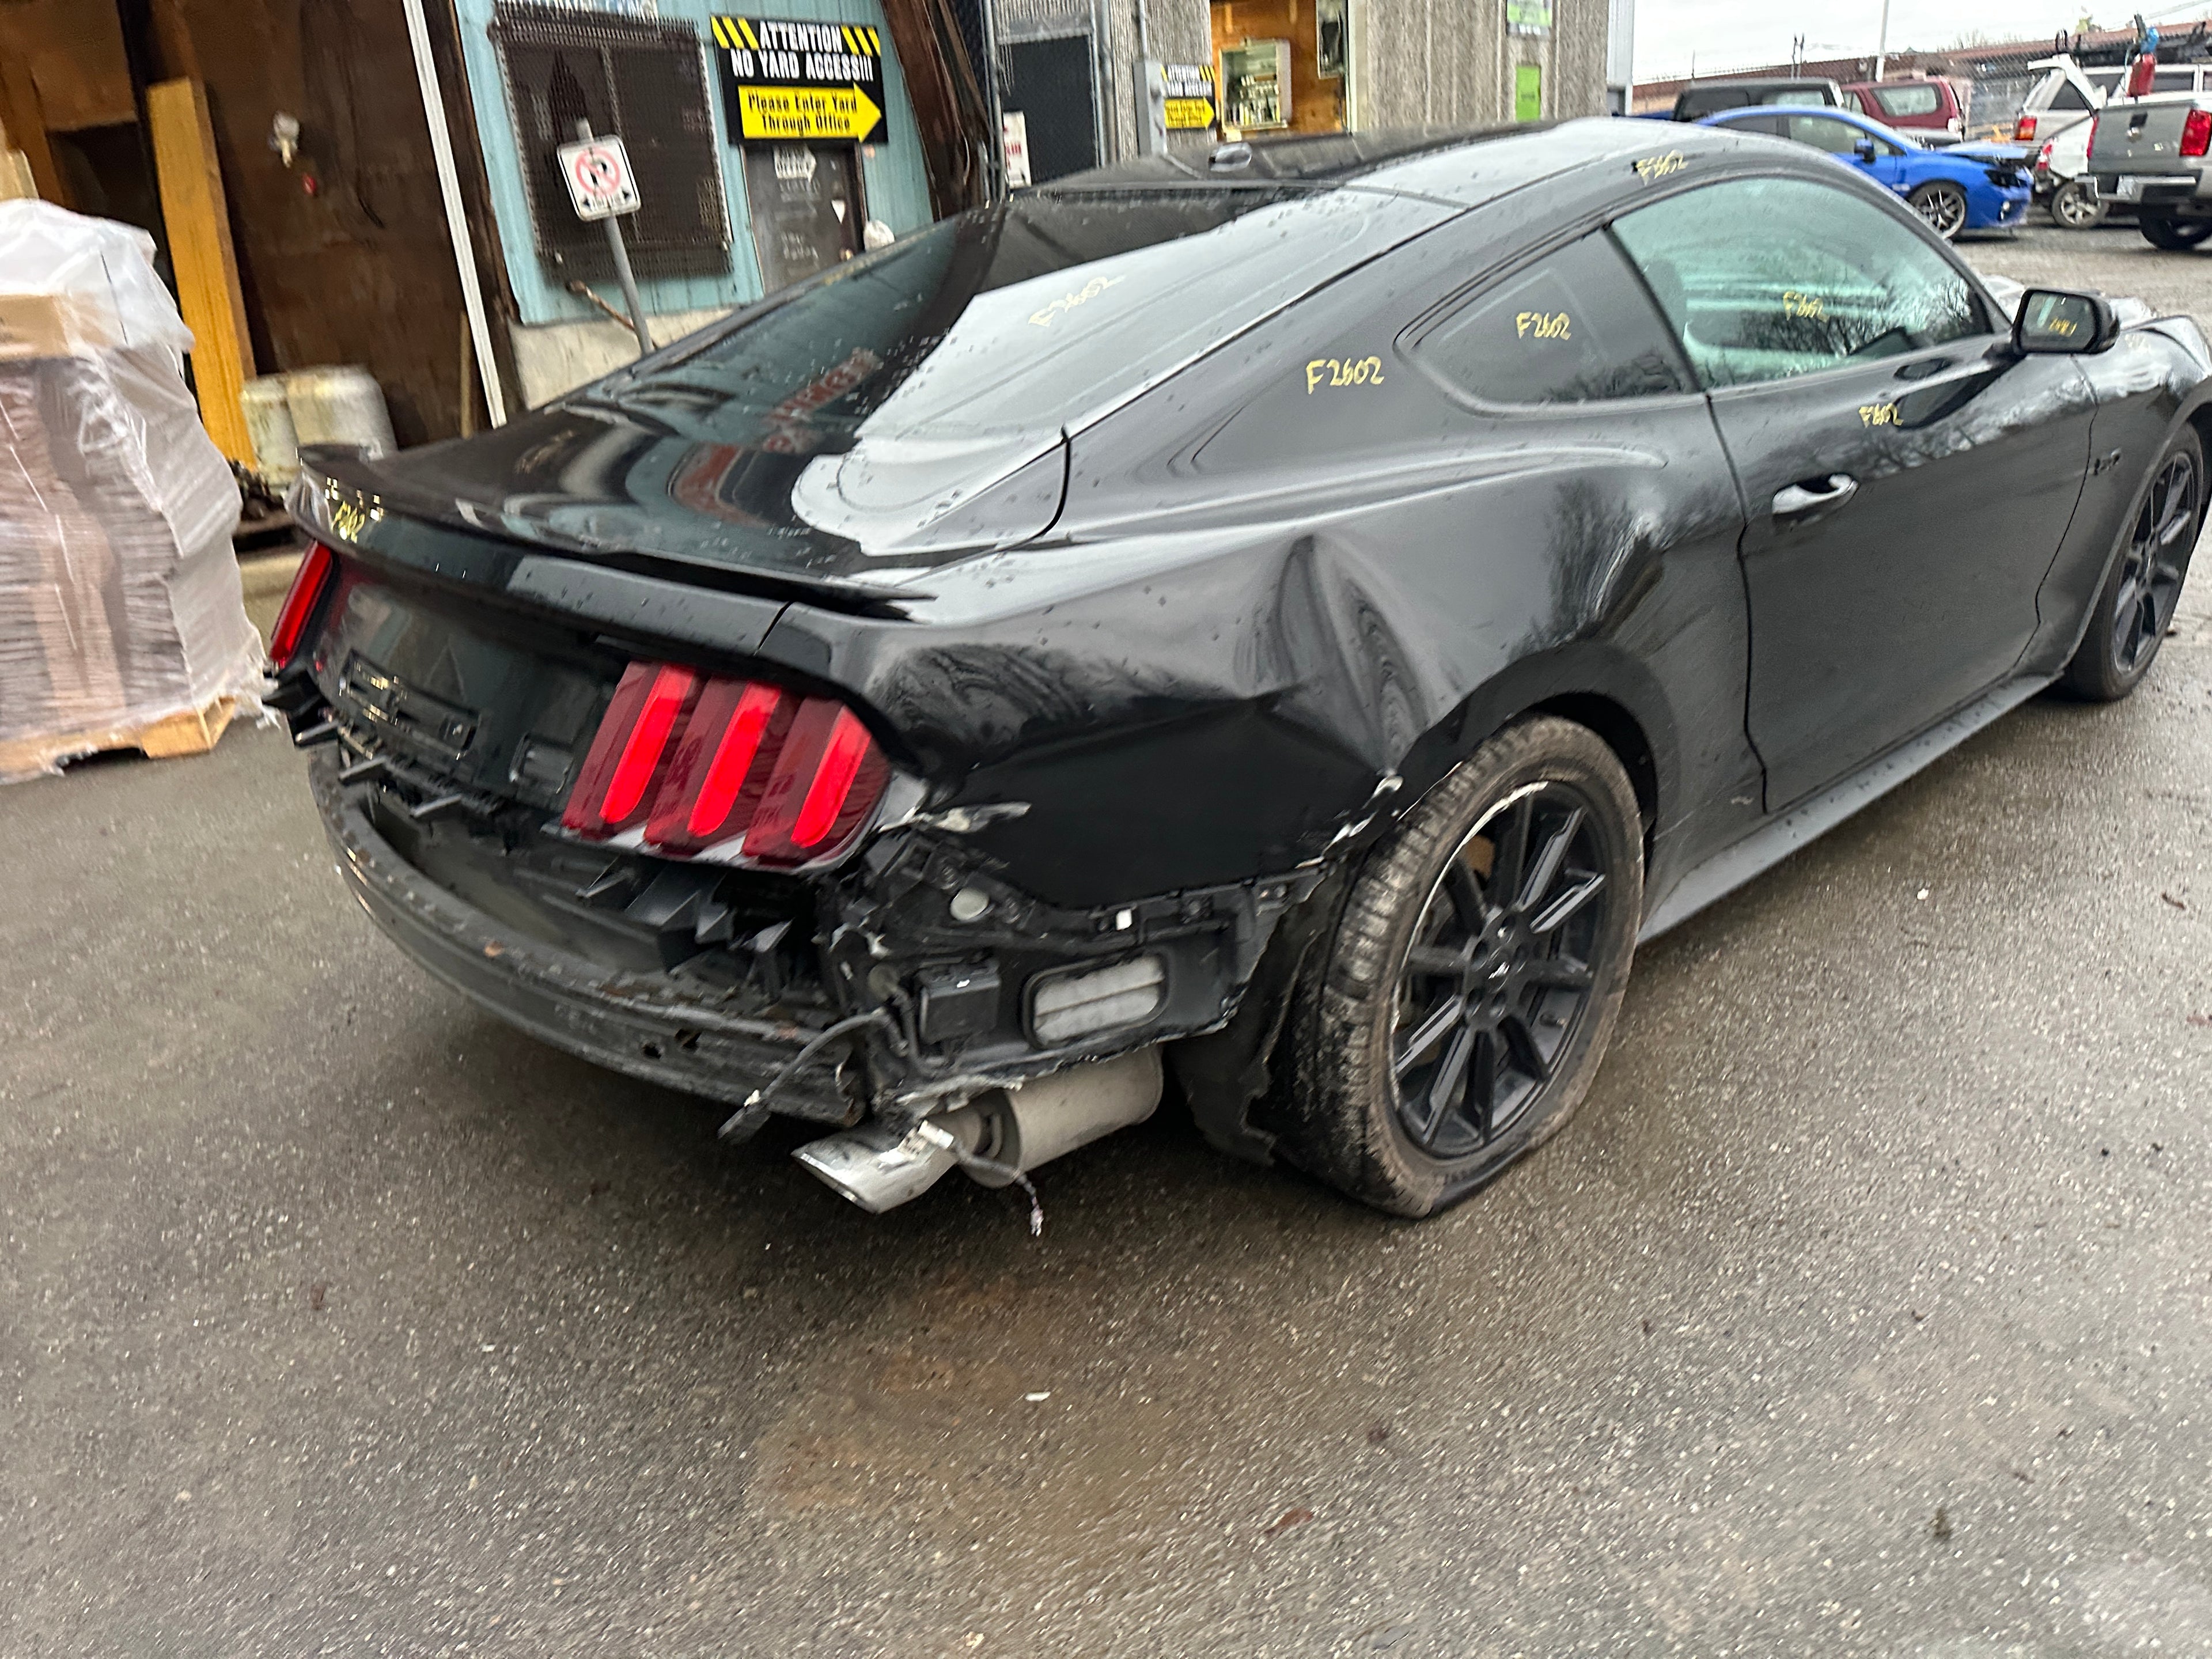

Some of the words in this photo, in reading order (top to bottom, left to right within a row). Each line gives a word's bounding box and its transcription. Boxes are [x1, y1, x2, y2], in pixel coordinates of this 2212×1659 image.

[759, 21, 843, 54] ATTENTION
[730, 48, 754, 78] NO
[758, 50, 800, 79] YARD
[805, 52, 874, 82] ACCESS!!!
[747, 89, 790, 113] Please
[794, 90, 827, 115] Enter
[831, 90, 857, 114] Yard
[760, 112, 811, 137] Through
[815, 115, 851, 134] Office
[1516, 312, 1572, 340] F2602
[1305, 355, 1385, 395] F2602
